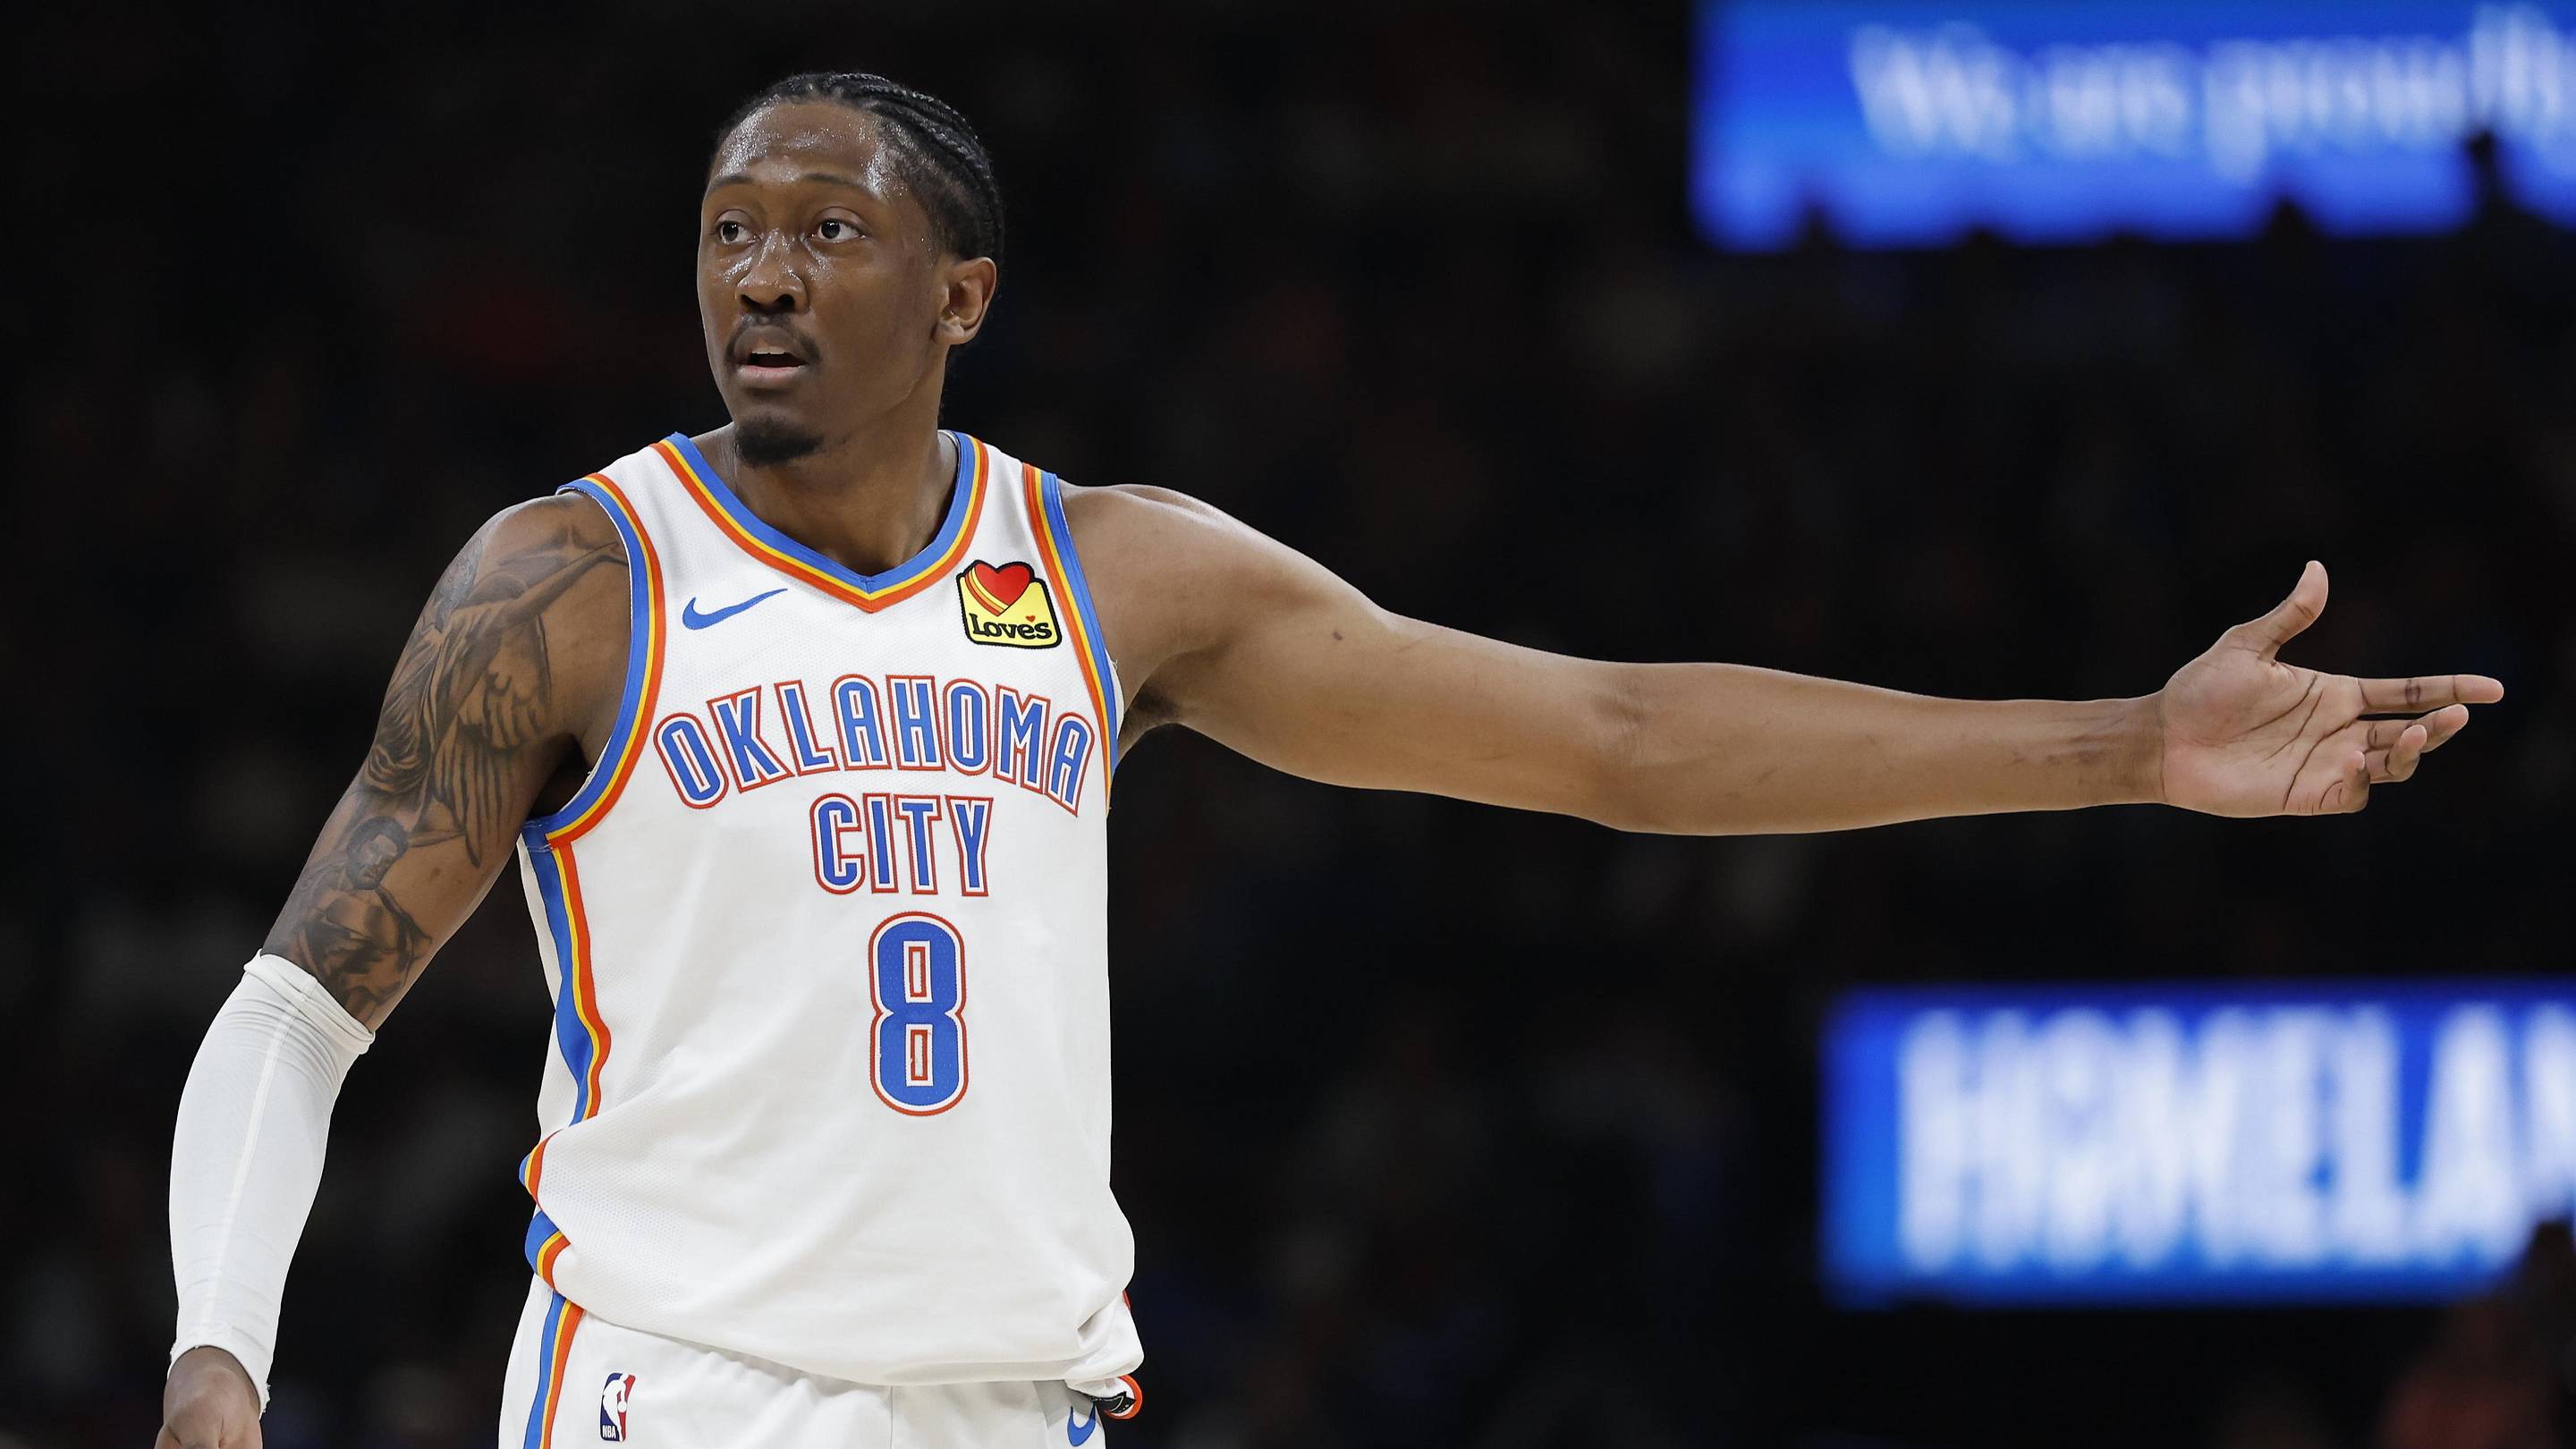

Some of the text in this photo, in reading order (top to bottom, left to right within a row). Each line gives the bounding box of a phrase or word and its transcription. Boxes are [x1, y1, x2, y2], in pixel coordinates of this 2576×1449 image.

[653, 674, 1095, 817] OKLAHOMA
[809, 792, 995, 897] CITY
[869, 911, 969, 1117] 8
[602, 1425, 616, 1438] NBA
